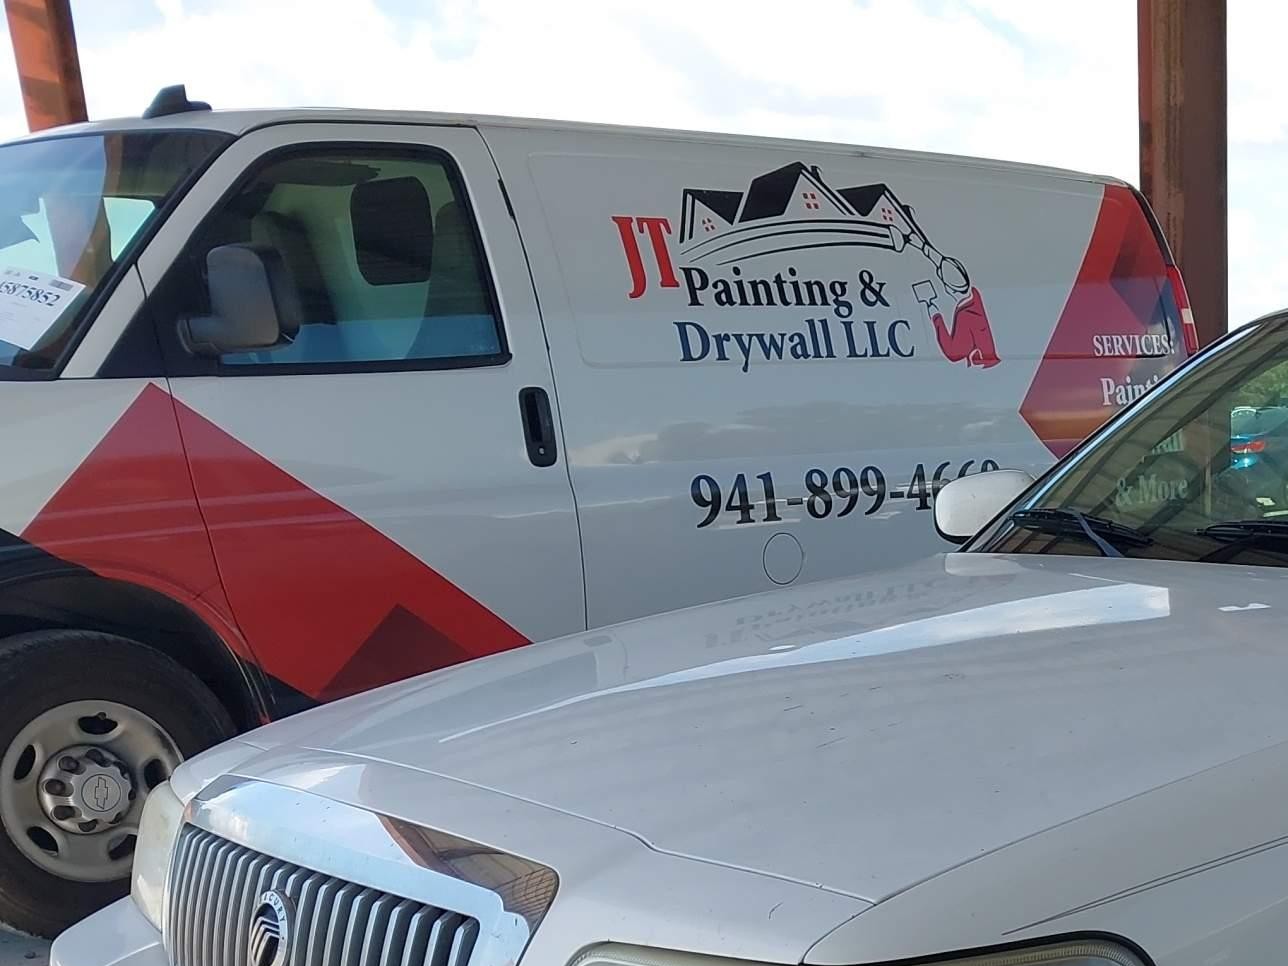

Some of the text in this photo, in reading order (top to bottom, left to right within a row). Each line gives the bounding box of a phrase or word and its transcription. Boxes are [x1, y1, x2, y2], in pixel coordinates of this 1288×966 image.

[611, 216, 680, 300] JT
[679, 265, 891, 318] Painting &
[673, 318, 916, 373] Drywall LLC
[1092, 333, 1176, 357] SERVICES:
[690, 459, 1000, 529] 941-899-46
[1137, 473, 1189, 504] More
